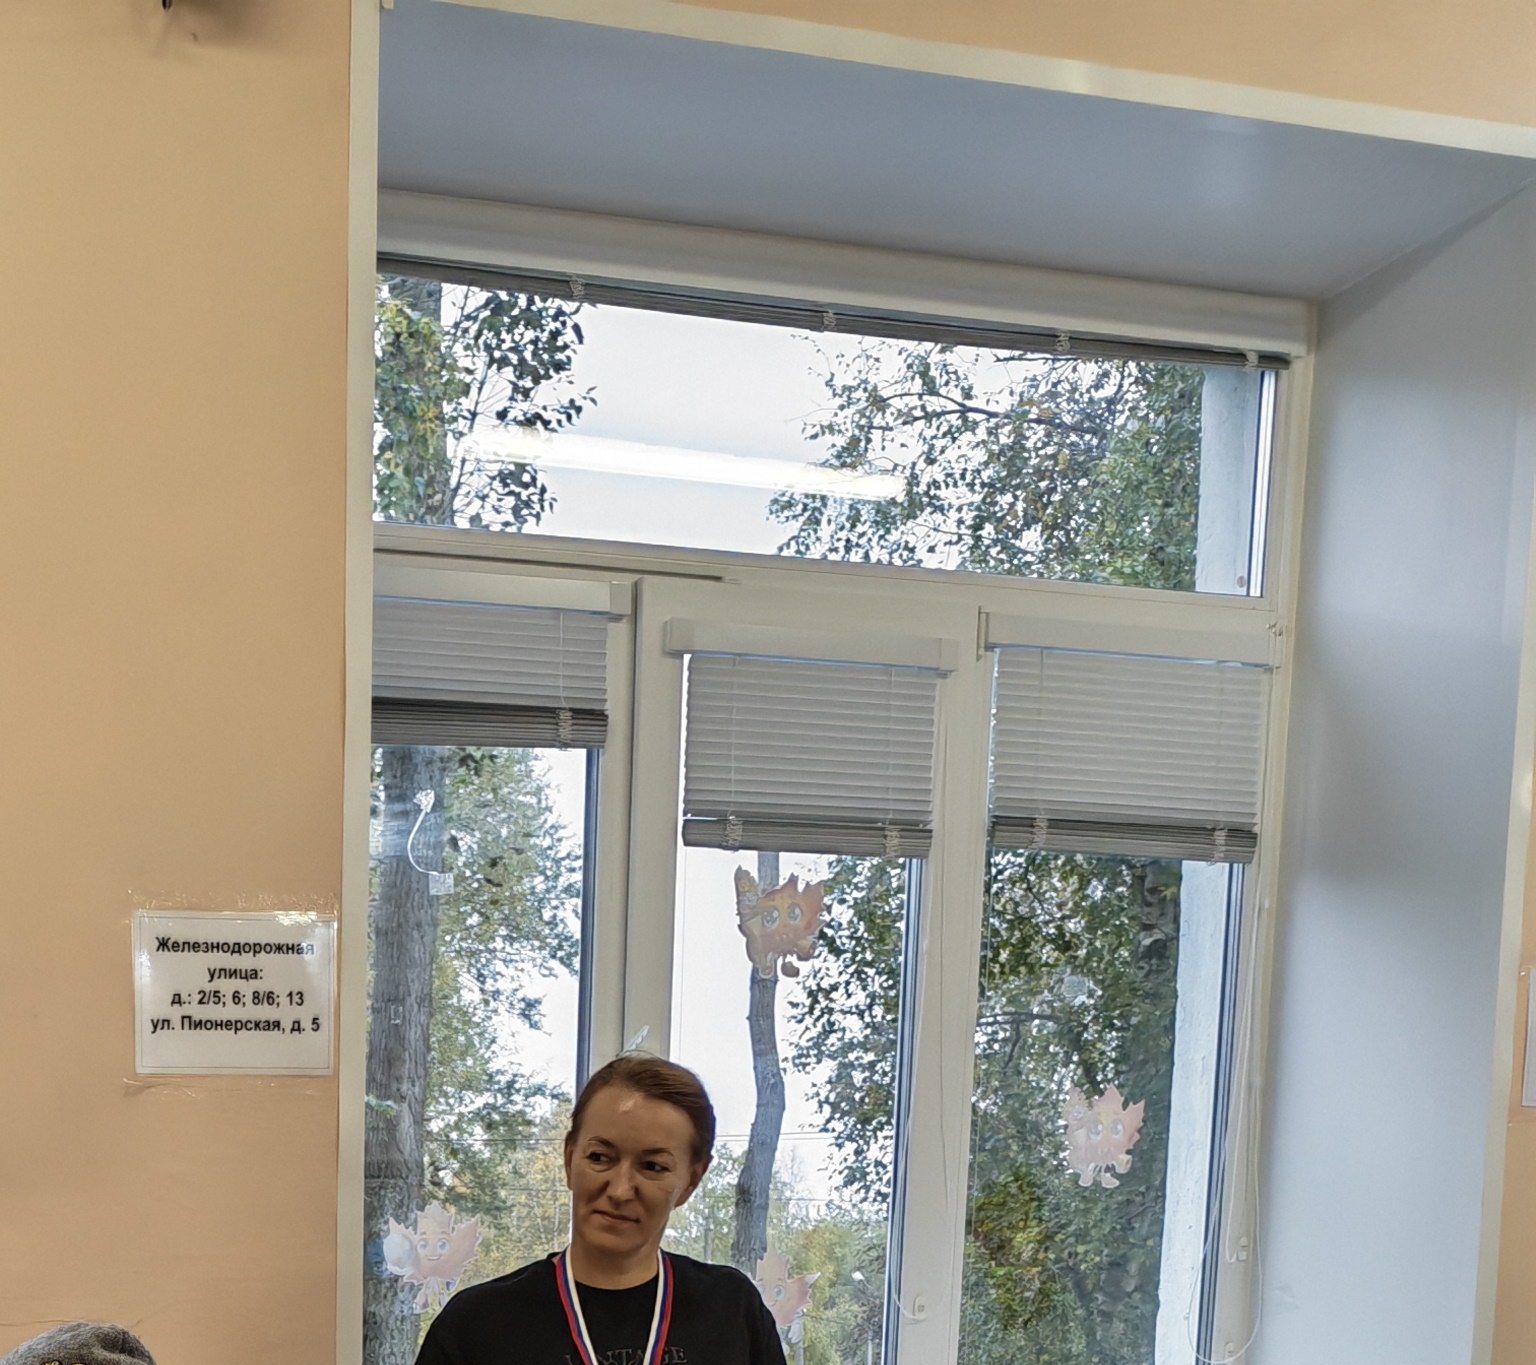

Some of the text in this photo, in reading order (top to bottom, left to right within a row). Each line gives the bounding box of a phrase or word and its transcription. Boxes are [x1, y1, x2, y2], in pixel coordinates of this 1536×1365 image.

[155, 936, 315, 957] Железнодорожная
[207, 967, 264, 983] улица:
[170, 990, 305, 1008] д.: 2/5; 6; 8/6; 13
[150, 1016, 321, 1034] ул. Пионерская, д. 5
